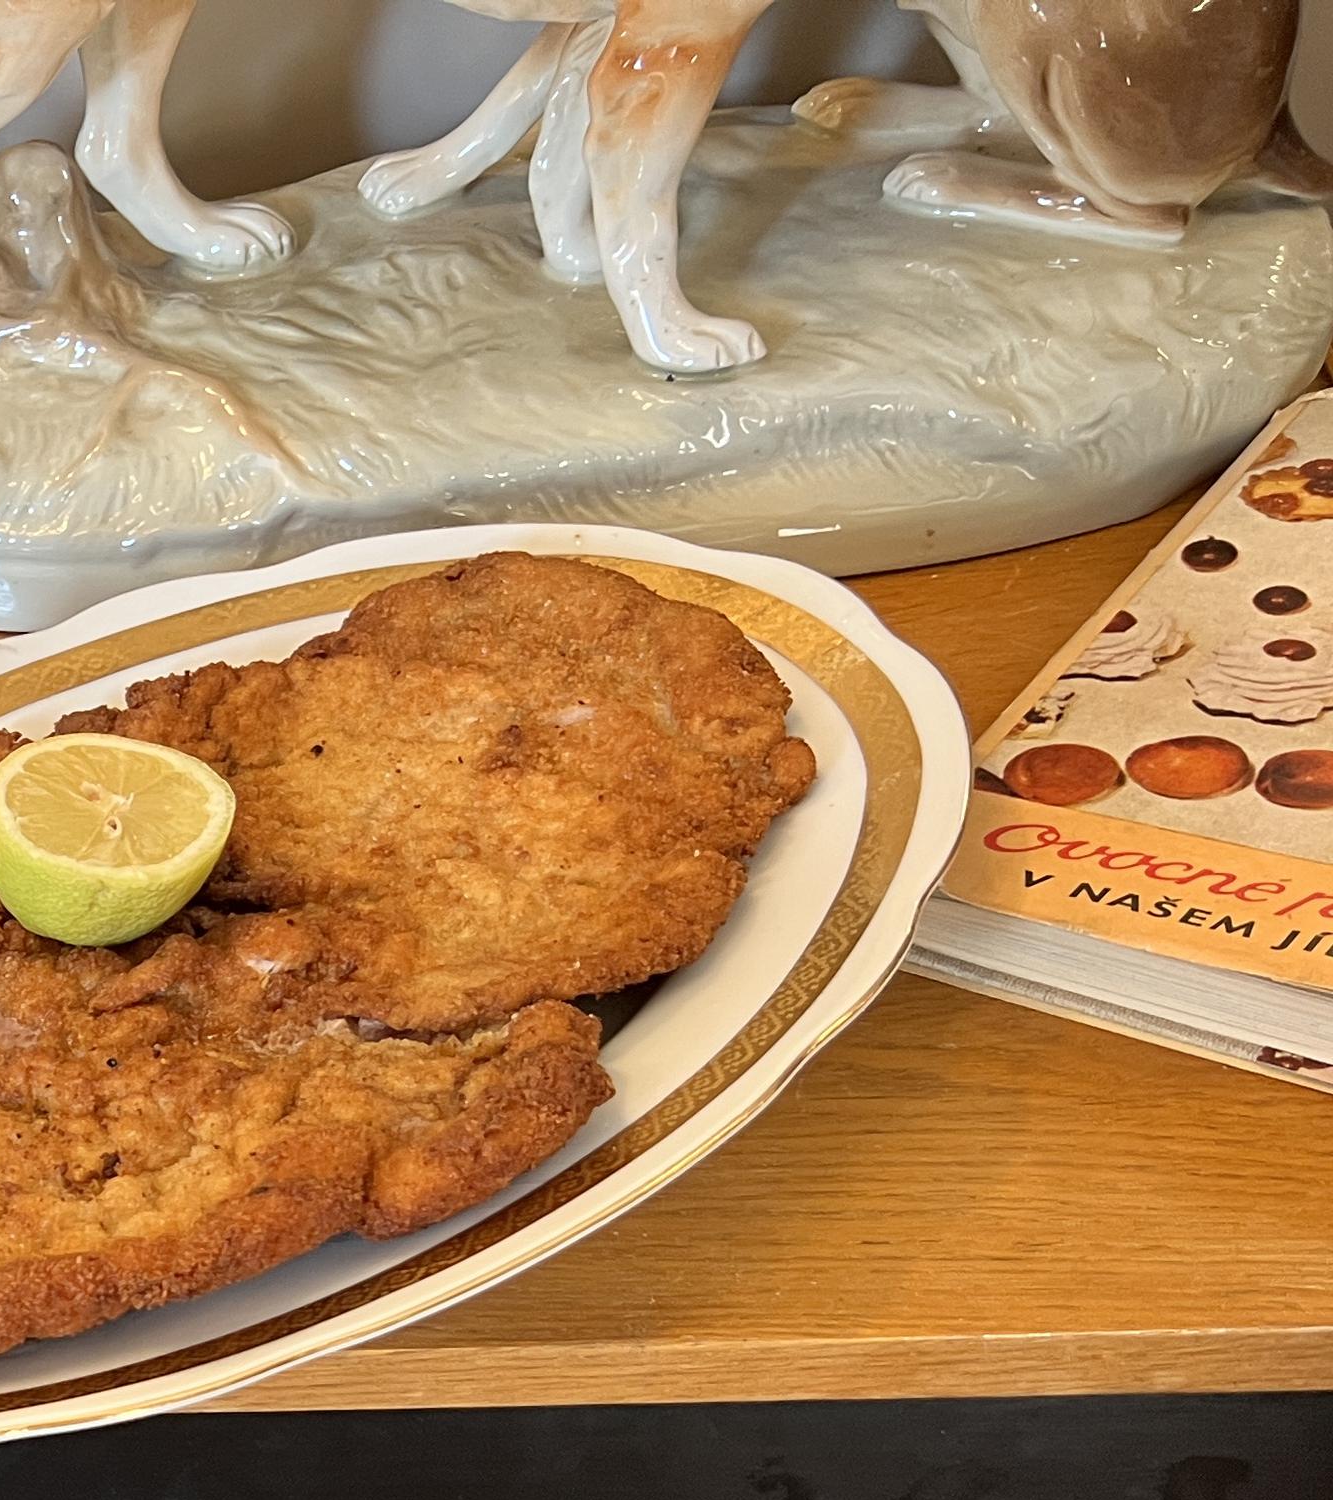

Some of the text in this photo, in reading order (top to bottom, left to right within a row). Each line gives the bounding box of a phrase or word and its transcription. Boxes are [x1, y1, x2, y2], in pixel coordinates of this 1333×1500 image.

[983, 824, 1292, 903] Ovocné
[1025, 870, 1055, 888] V
[1068, 882, 1255, 939] NAŠEM
